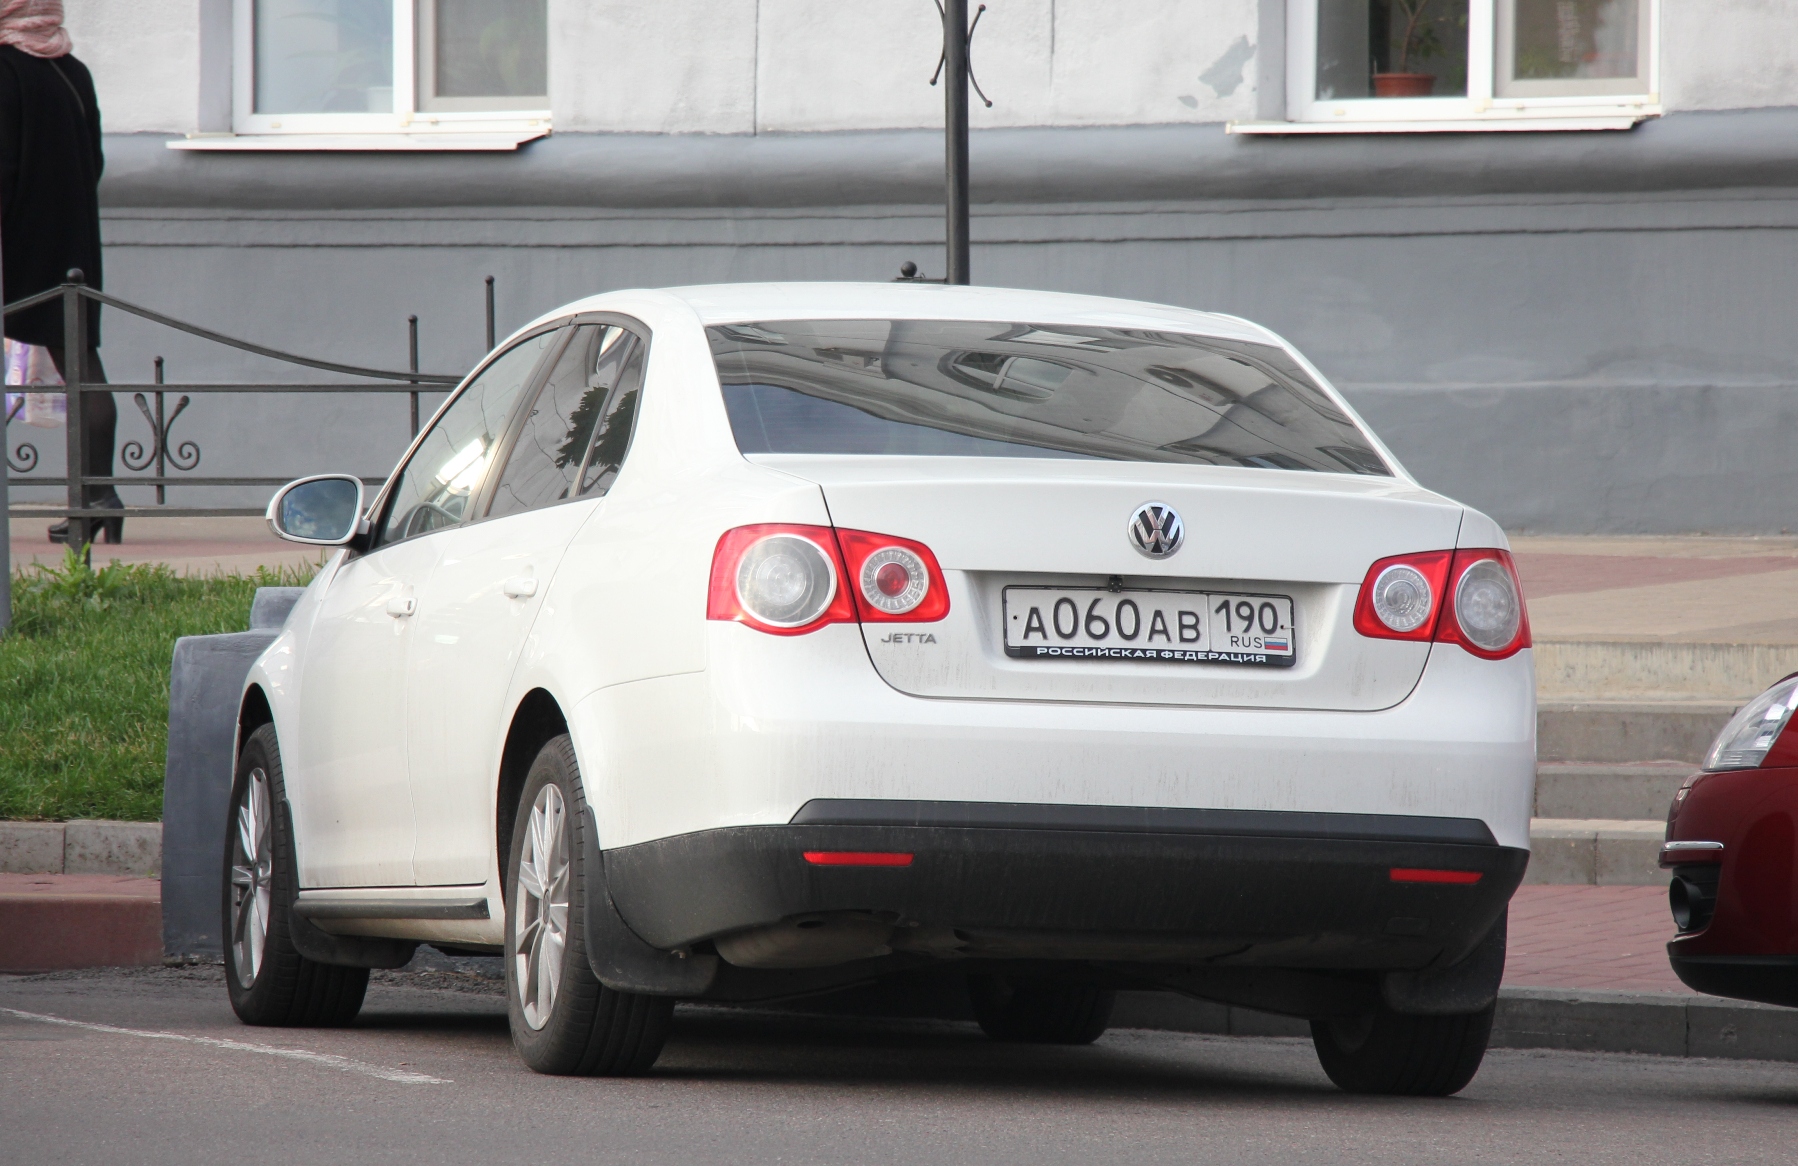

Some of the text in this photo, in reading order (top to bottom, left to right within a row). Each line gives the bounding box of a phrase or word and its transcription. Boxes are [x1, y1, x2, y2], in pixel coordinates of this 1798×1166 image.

[1214, 599, 1279, 635] 190
[881, 632, 937, 644] JETTA
[1230, 635, 1263, 648] RUS
[1036, 646, 1267, 663] РОССИЙСКАЯ ФЕДЕРАЦИЯ
